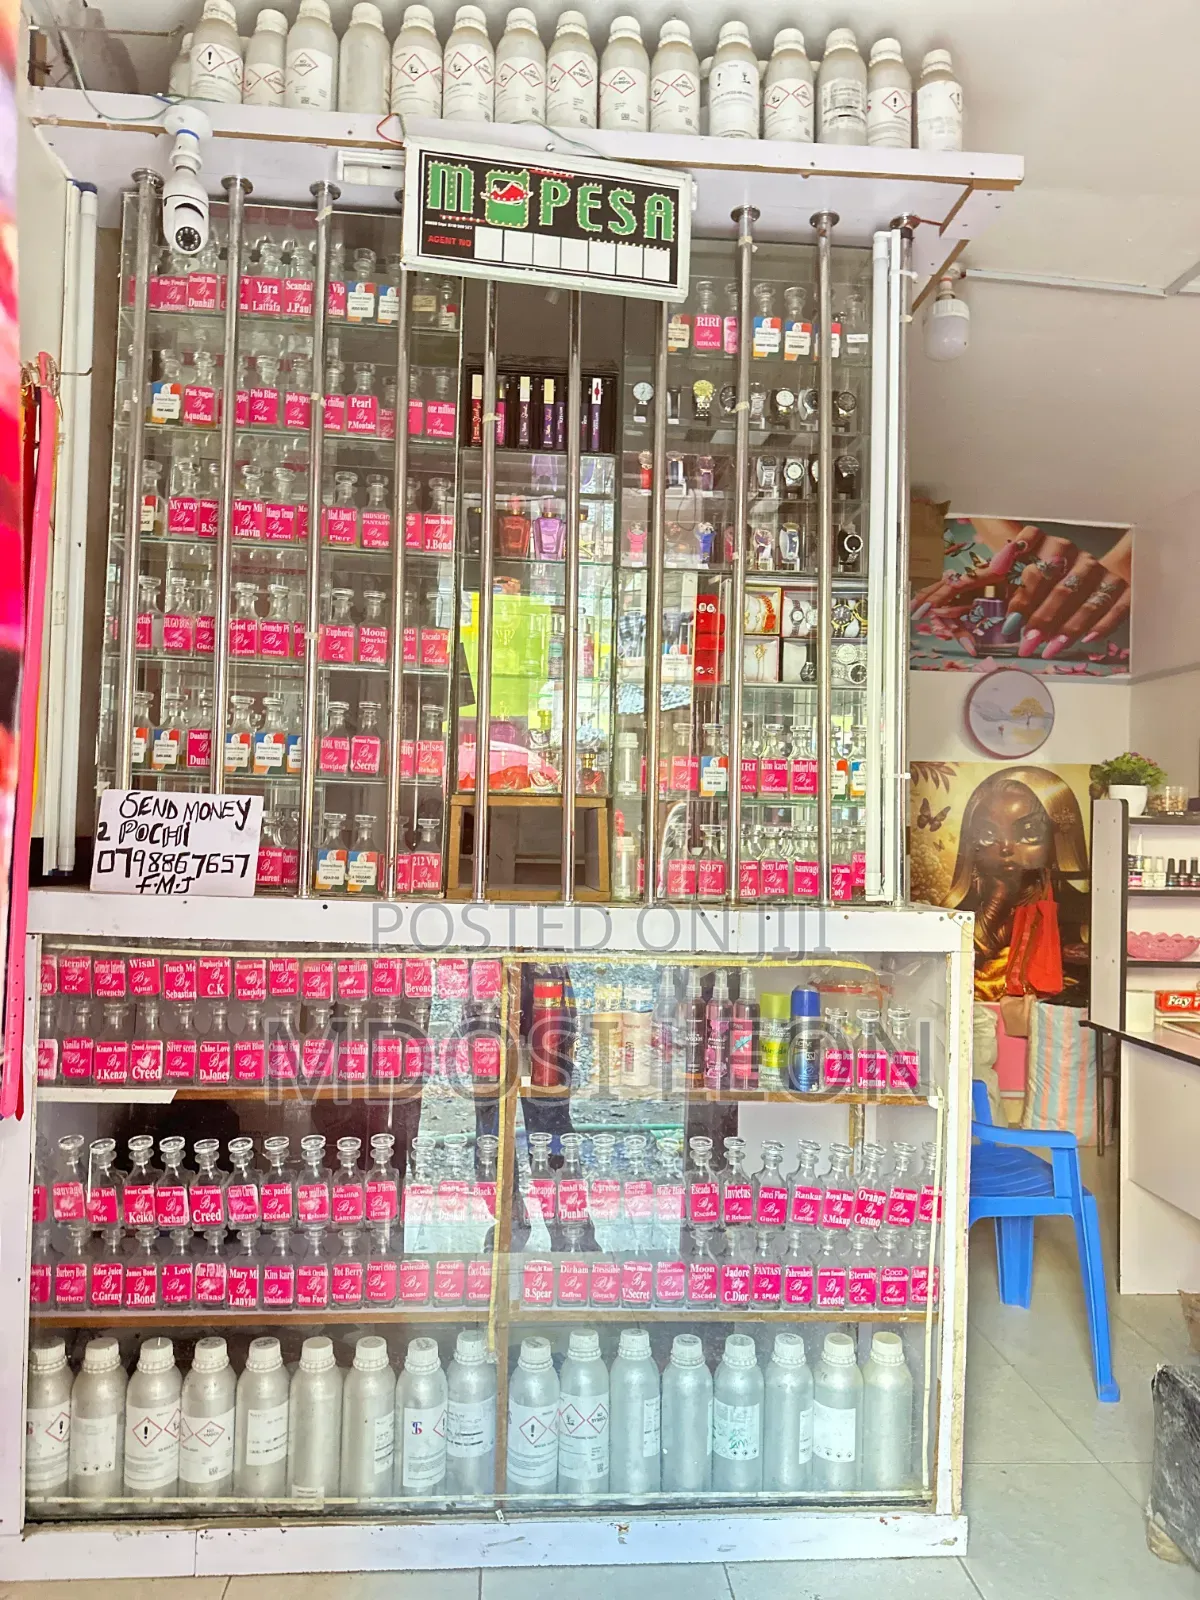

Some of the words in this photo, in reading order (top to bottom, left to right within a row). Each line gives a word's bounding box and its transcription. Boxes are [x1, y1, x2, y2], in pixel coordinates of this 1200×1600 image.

[538, 176, 676, 242] PESA
[428, 235, 456, 246] AGENT
[458, 239, 472, 247] NO
[257, 280, 278, 294] Yara
[286, 280, 313, 293] Scandal
[332, 283, 345, 297] Vip
[188, 297, 215, 309] Dunhill
[252, 300, 281, 313] Lattafa
[286, 302, 313, 315] J.Paul
[697, 316, 721, 327] RIRI
[186, 388, 198, 396] Pink
[199, 389, 214, 399] Sugar
[250, 389, 262, 398] Polo
[263, 390, 278, 399] Blue
[285, 393, 299, 403] polo
[352, 396, 372, 408] Pearl
[184, 410, 211, 421] Aquolina
[348, 420, 376, 430] P.Montale
[169, 499, 181, 512] My
[183, 501, 197, 512] way
[234, 502, 252, 513] Mary
[439, 517, 453, 525] Bond
[234, 525, 260, 537] Lanvin
[425, 539, 453, 550] J.Bond
[230, 622, 246, 631] Good
[247, 621, 257, 632] girl
[325, 627, 354, 639] Euphoria
[361, 627, 386, 638] Moon
[421, 632, 441, 641] Escada
[263, 632, 282, 648] By
[360, 654, 385, 663] Escada
[424, 656, 445, 664] Escada
[417, 741, 443, 752] Chelsea
[761, 761, 774, 770] kim
[119, 792, 179, 819] SEND
[183, 797, 252, 831] MONEY
[97, 821, 111, 841] 2
[118, 819, 191, 848] POCHI
[97, 847, 251, 879] 0798867657
[413, 856, 425, 868] 212
[427, 857, 439, 870] Vip
[700, 863, 724, 874] SOFT
[762, 861, 776, 873] Sexy
[777, 861, 788, 871] Love
[412, 878, 439, 889] Carolina
[765, 886, 786, 894] Paris
[130, 959, 154, 969] Wisal
[165, 964, 184, 973] Touch
[187, 963, 197, 972] Me
[200, 960, 226, 970] Euphoria
[270, 961, 285, 972] Ocean
[374, 961, 389, 970] Gucci
[100, 973, 119, 988] By
[132, 971, 152, 986] By
[246, 970, 263, 988] By
[413, 967, 430, 984] By
[175, 972, 191, 991] By
[308, 976, 328, 991] By
[97, 989, 126, 998] Givenchy
[134, 985, 152, 993] Ajmal
[166, 989, 197, 999] Sebastian
[207, 984, 225, 996] C.K
[1168, 994, 1191, 1007] Fay
[167, 1042, 181, 1052] Silver
[200, 1044, 215, 1052] Chloe
[217, 1044, 230, 1052] Love
[305, 1040, 325, 1049] Berry
[826, 1050, 843, 1060] Golden
[67, 1054, 87, 1068] By
[209, 1053, 225, 1071] By
[271, 1054, 289, 1070] By
[97, 1069, 127, 1080] J.Kenzo
[132, 1066, 161, 1080] Creed
[200, 1069, 229, 1080] D.Jones
[339, 1069, 365, 1081] Aquolina
[102, 1188, 116, 1197] Red
[474, 1186, 491, 1196] Black
[692, 1184, 710, 1194] Escada
[760, 1190, 774, 1199] Gucci
[826, 1191, 842, 1202] Royal
[843, 1193, 854, 1201] Blue
[859, 1189, 886, 1205] Orange
[200, 1195, 216, 1212] By
[93, 1214, 107, 1222] Polo
[129, 1211, 153, 1223] Keiko
[193, 1209, 221, 1222] Creed
[823, 1214, 850, 1227] S.Makup
[854, 1213, 881, 1226] Cosmo
[94, 1267, 107, 1275] Eden
[126, 1268, 142, 1276] James
[143, 1268, 157, 1276] Bond
[162, 1267, 170, 1275] J.
[175, 1266, 193, 1275] Low
[230, 1268, 249, 1280] Mary
[265, 1269, 278, 1279] Kim
[299, 1268, 312, 1276] Black
[346, 1267, 363, 1277] Berry
[561, 1264, 588, 1274] Dirham
[690, 1264, 714, 1273] Moon
[725, 1266, 750, 1278] Jadore
[754, 1266, 781, 1276] FANTASY
[595, 1276, 616, 1291] By
[127, 1292, 155, 1304] J.Bond
[298, 1294, 311, 1303] Tom
[313, 1294, 327, 1303] Ford
[525, 1288, 552, 1300] B.Spear
[622, 1287, 650, 1300] V.Secret
[725, 1292, 748, 1302] C.Dior
[230, 1295, 256, 1306] Lanvin
[817, 1294, 844, 1305] Lacoste
